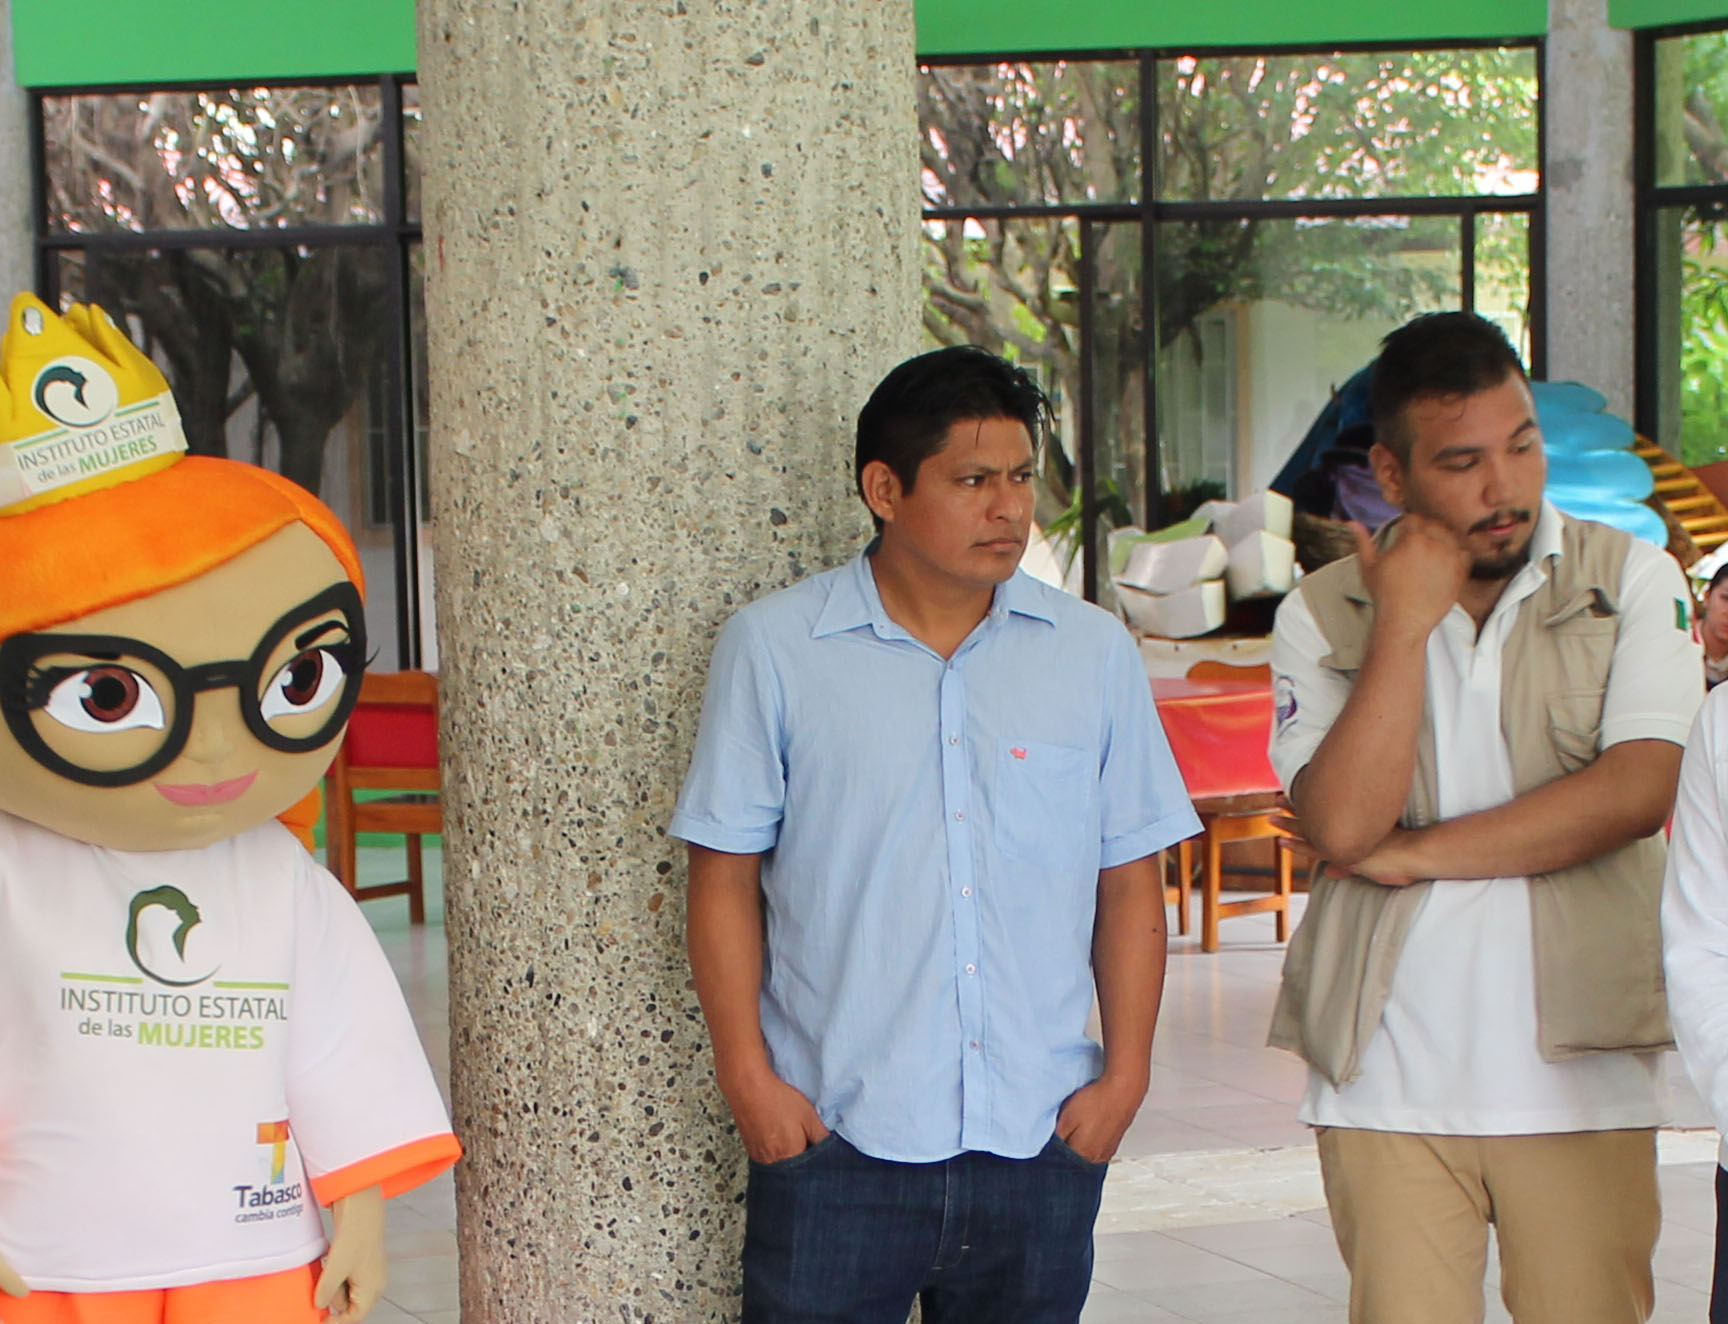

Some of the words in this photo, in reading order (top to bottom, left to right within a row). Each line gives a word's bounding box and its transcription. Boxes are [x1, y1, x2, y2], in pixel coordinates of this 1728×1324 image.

[17, 429, 108, 471] INSTITUTO
[110, 412, 165, 442] ESTATAL
[37, 467, 54, 484] de
[57, 459, 77, 477] las
[78, 435, 158, 474] MUJERES
[60, 987, 192, 1018] INSTITUTO
[199, 996, 288, 1021] ESTATAL
[77, 1017, 103, 1037] de
[107, 1019, 133, 1038] las
[137, 1021, 265, 1049] MUJERES
[232, 1182, 302, 1208] Tabasco
